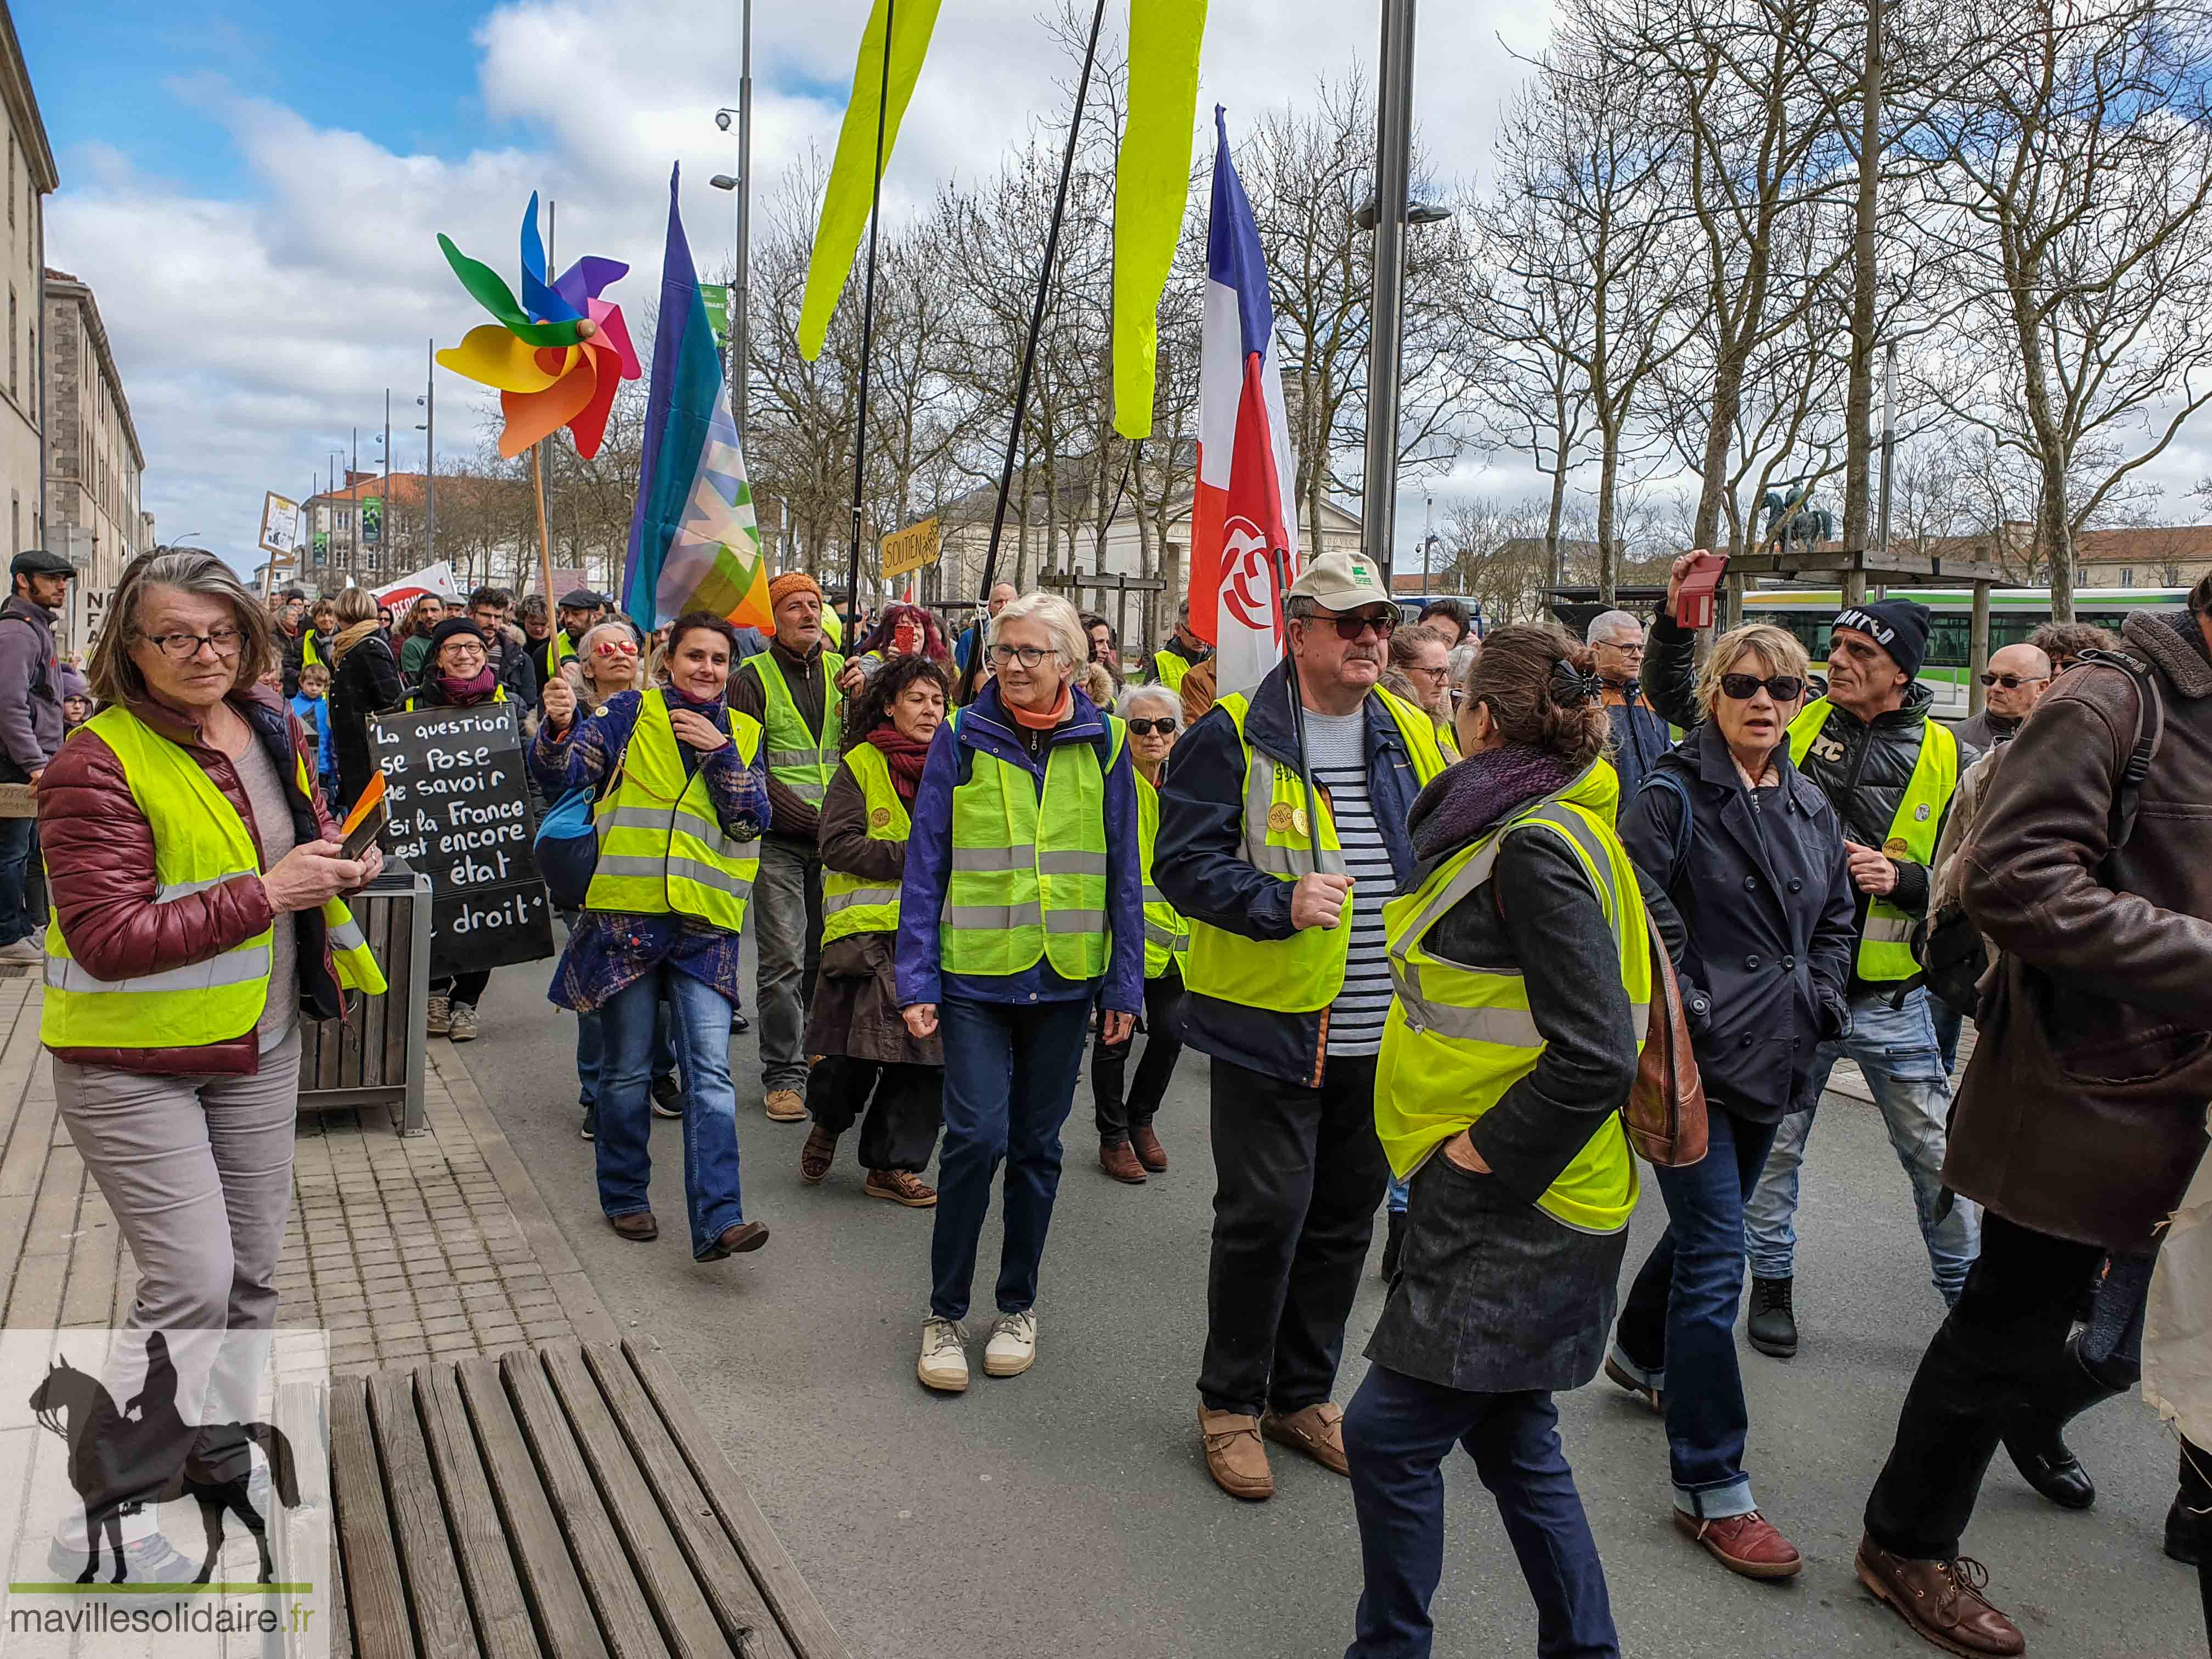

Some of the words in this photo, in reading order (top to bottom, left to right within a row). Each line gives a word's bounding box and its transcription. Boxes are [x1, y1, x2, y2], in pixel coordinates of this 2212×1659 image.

[416, 771, 505, 796] savoir
[448, 800, 524, 826] France
[395, 836, 428, 859] est
[439, 823, 527, 853] encore
[450, 850, 511, 885] état
